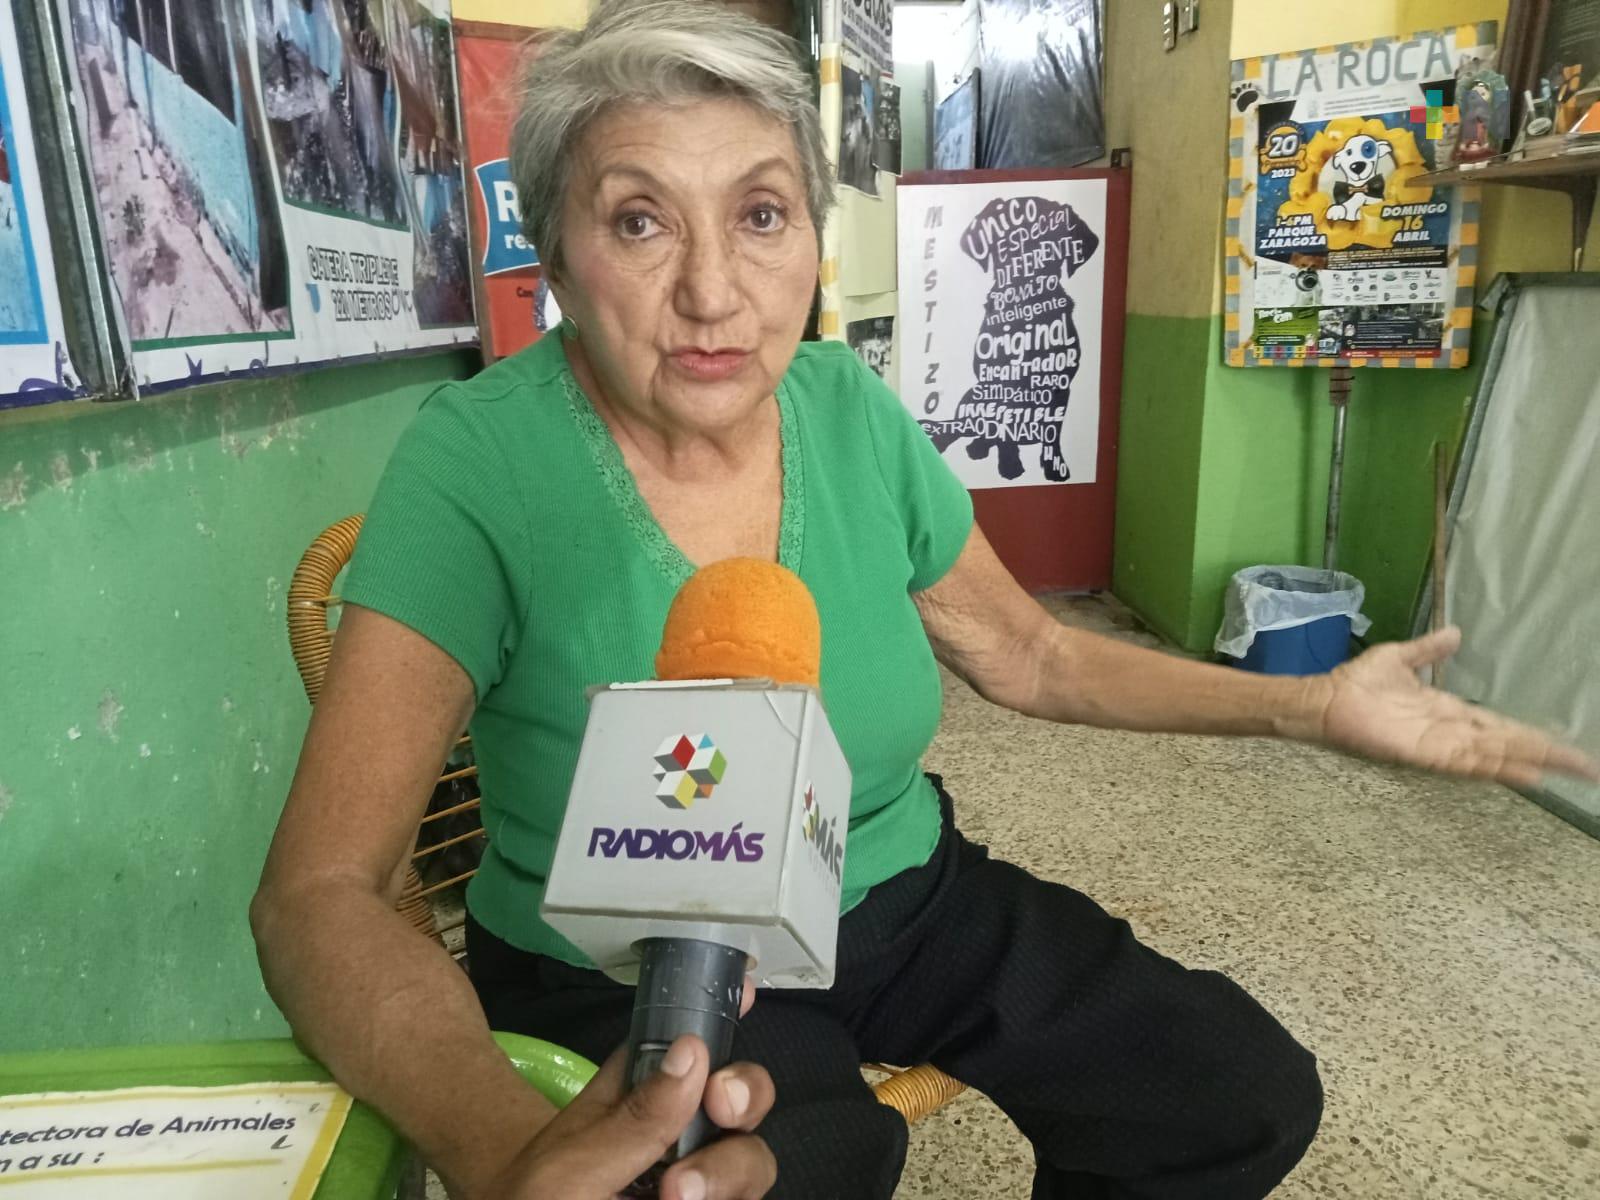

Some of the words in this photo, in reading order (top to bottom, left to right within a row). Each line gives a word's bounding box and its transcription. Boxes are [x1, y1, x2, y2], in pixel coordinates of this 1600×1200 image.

[1264, 56, 1322, 99] LA
[1337, 37, 1453, 88] ROCA
[1269, 134, 1298, 157] 20
[1271, 168, 1296, 179] 2023
[1382, 203, 1448, 217] DOMINGO
[1403, 215, 1424, 230] 16
[1268, 225, 1315, 238] PARQUE
[1393, 230, 1431, 242] ABRIL
[1259, 235, 1326, 249] ZARAGOZA
[996, 236, 1085, 288] DIFERENTE
[986, 297, 1068, 326] inteligente
[1030, 374, 1070, 390] RARO
[586, 821, 765, 863] RADIOMÁS
[115, 1118, 154, 1138] de
[160, 1112, 297, 1135] Animales
[19, 1155, 44, 1170] a
[47, 1152, 84, 1168] su
